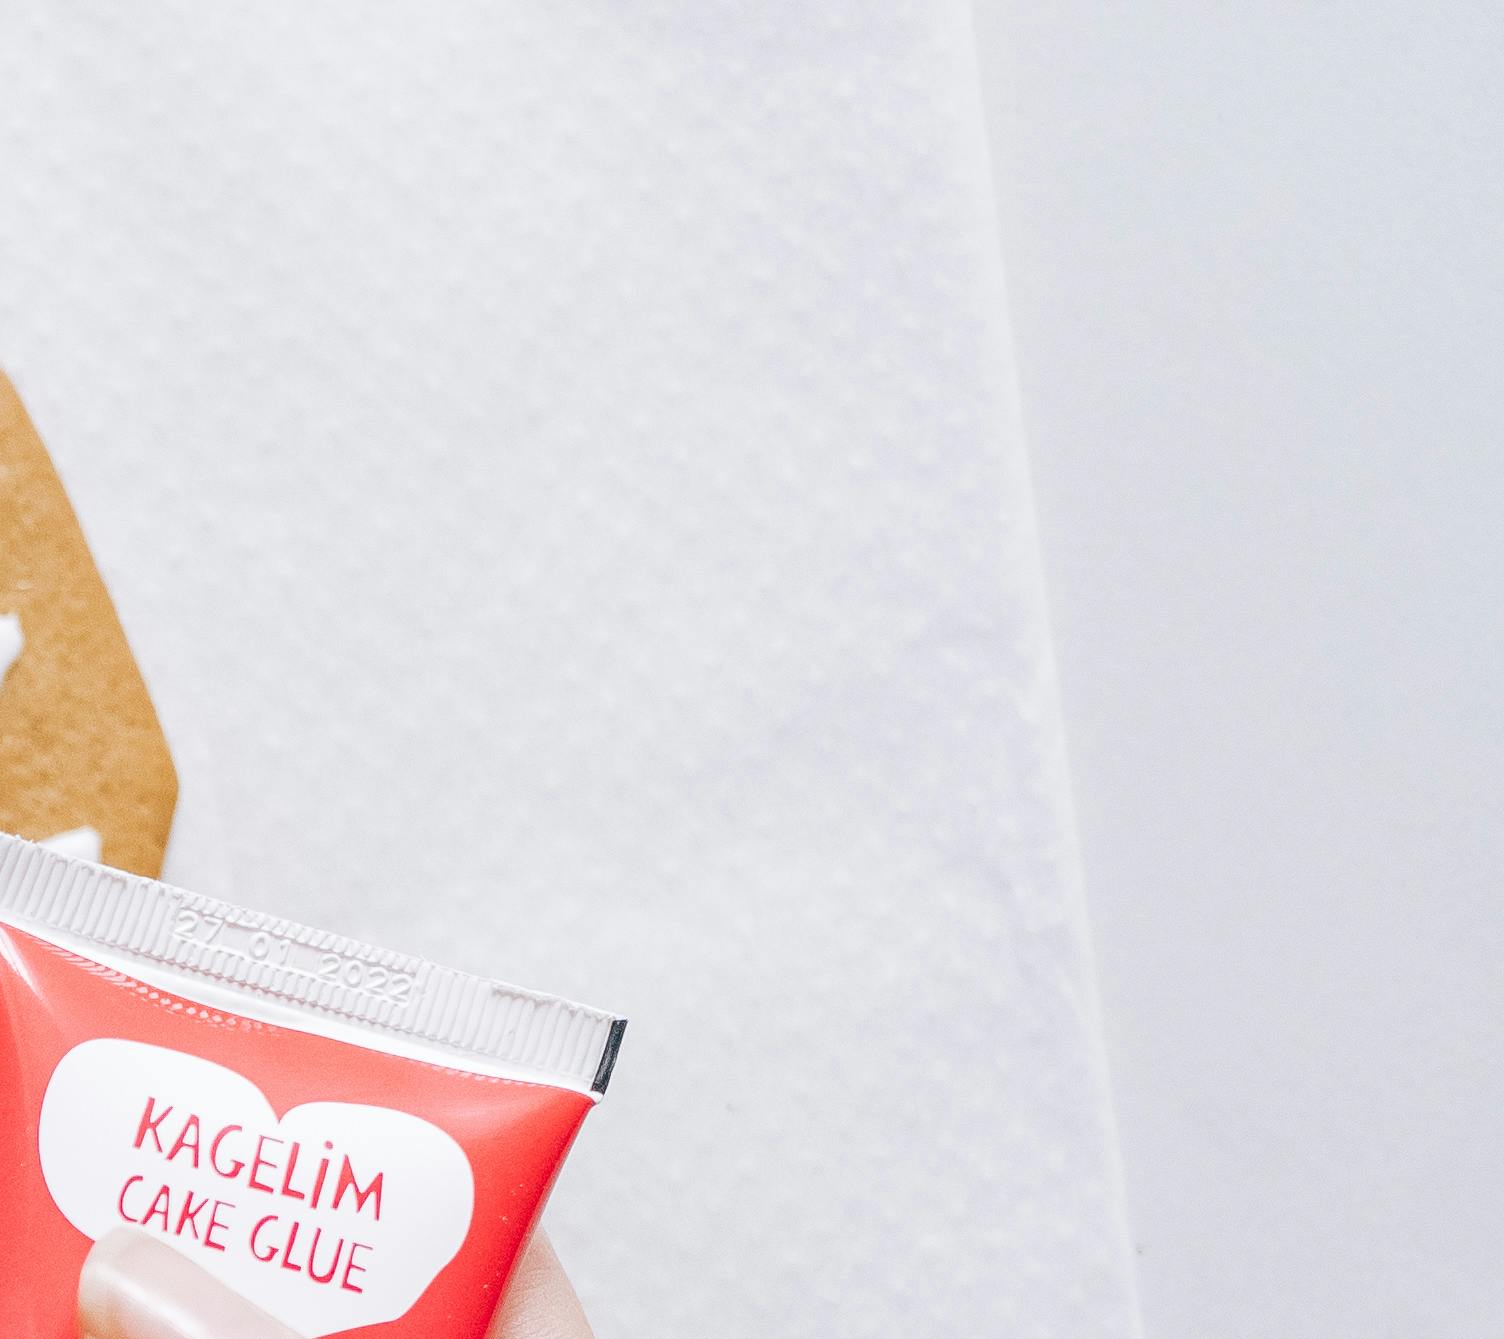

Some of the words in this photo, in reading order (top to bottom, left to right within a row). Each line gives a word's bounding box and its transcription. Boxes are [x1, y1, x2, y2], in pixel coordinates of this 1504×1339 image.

[172, 909, 226, 945] 27
[248, 931, 292, 966] 01
[317, 952, 415, 1002] 2022
[117, 1175, 236, 1252] CAKE
[249, 1215, 374, 1294] GLUE
